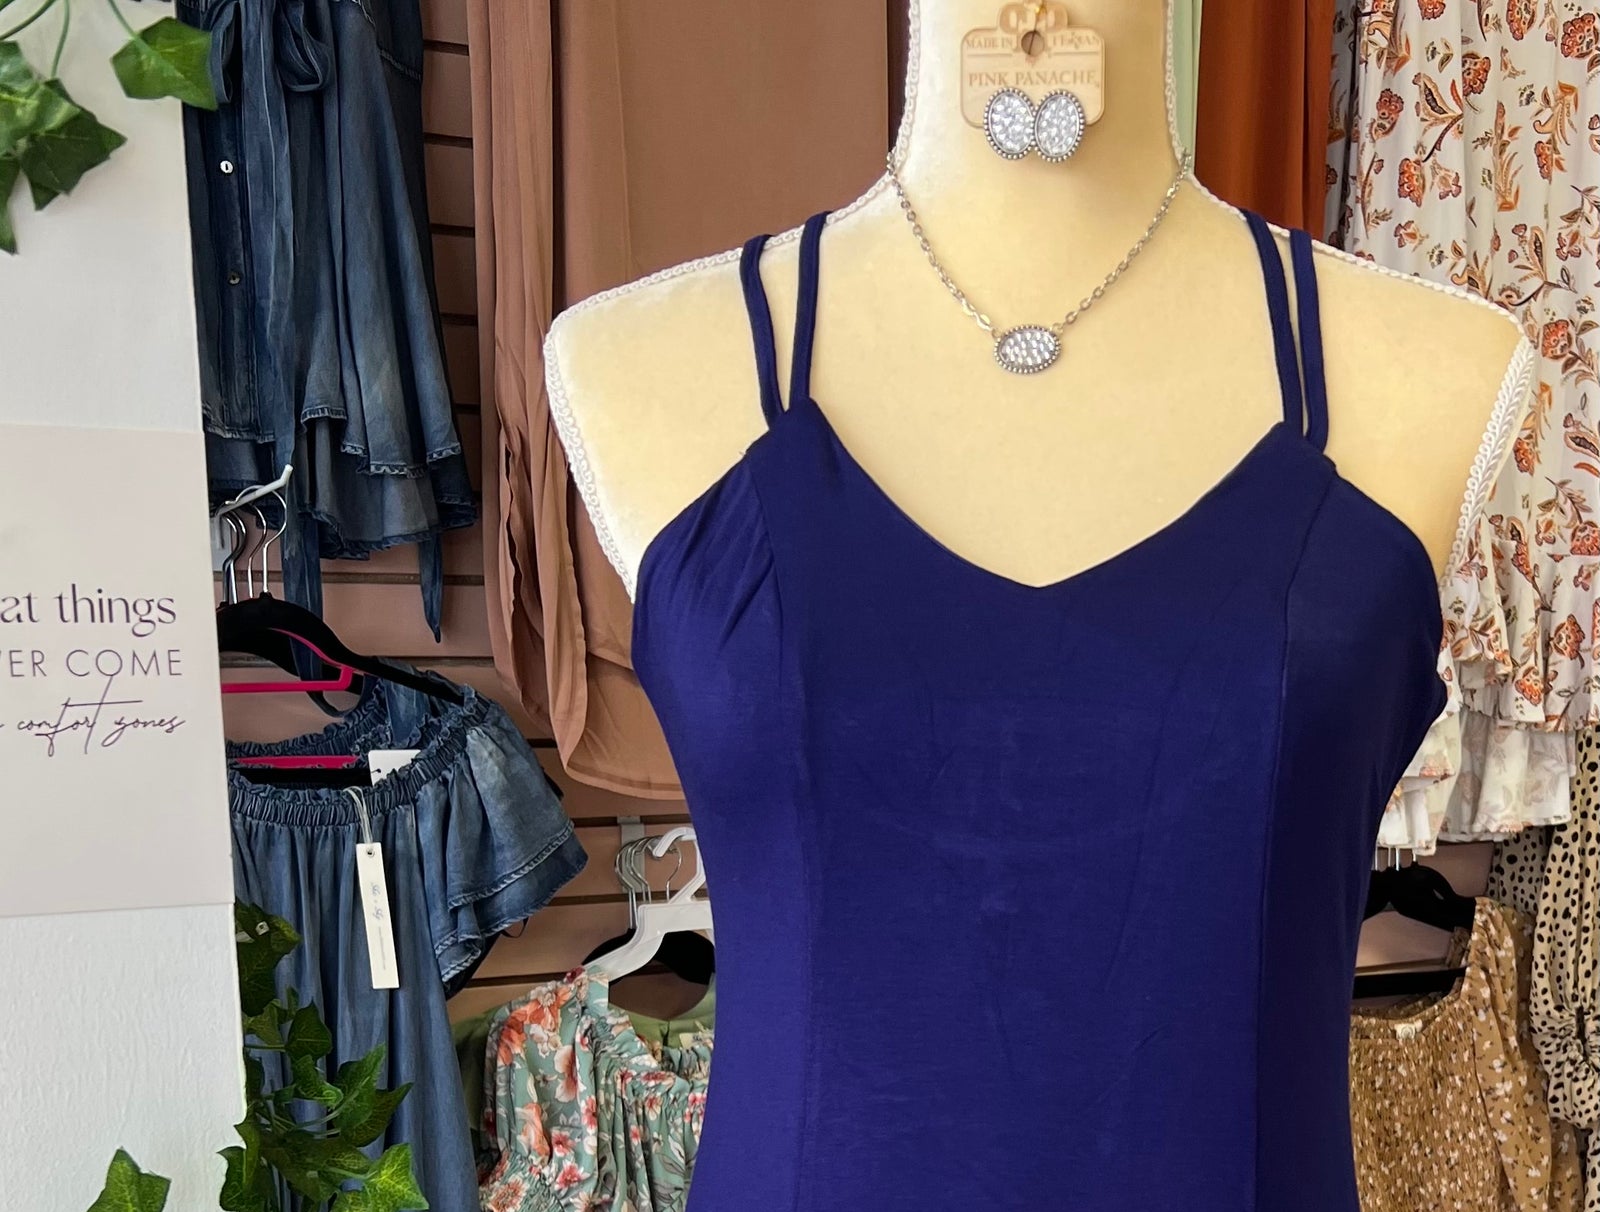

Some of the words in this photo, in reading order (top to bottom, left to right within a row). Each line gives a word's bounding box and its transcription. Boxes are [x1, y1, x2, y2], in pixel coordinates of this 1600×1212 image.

[968, 71, 1009, 87] PINK
[1015, 70, 1097, 86] PANACHE
[53, 583, 177, 637] things
[0, 649, 47, 677] ER
[66, 649, 183, 677] COME
